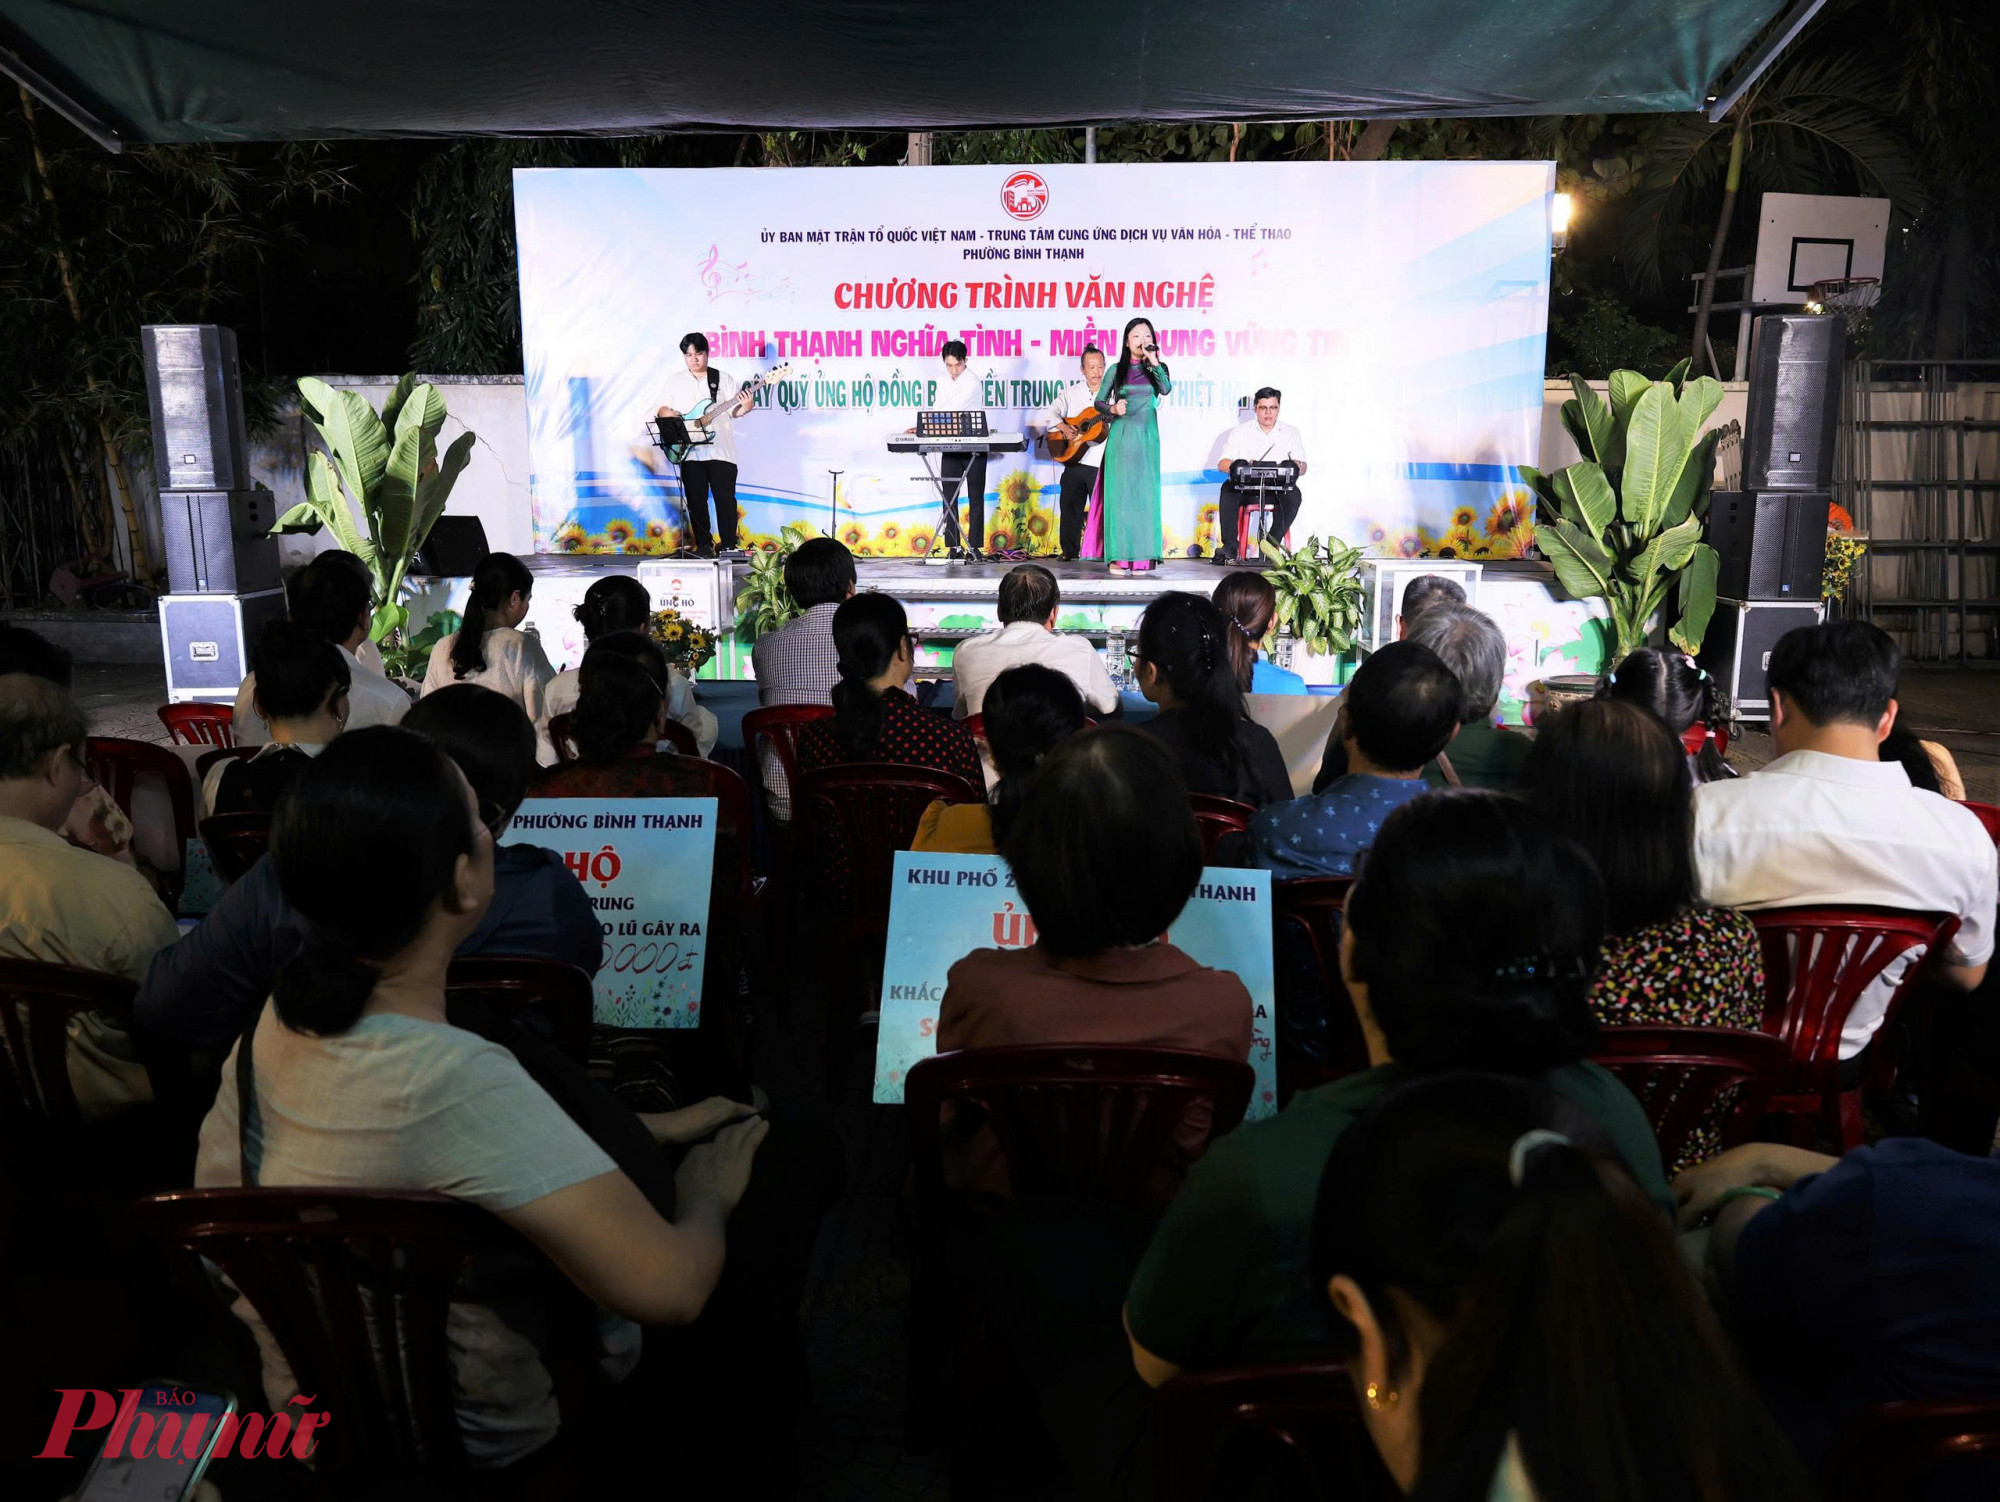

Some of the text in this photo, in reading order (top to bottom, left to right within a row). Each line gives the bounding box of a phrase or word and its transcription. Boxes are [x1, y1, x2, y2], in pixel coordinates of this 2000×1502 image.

[760, 227, 775, 243] ỦY
[780, 231, 802, 243] BAN
[835, 229, 865, 246] TRẬN
[869, 225, 885, 242] TỔ
[887, 226, 918, 244] QUỐC
[921, 228, 947, 245] VIỆT
[951, 230, 976, 241] NAM
[988, 229, 1026, 241] TRUNG
[1030, 226, 1055, 241] TÂM
[1058, 229, 1090, 241] CUNG
[1093, 225, 1117, 241] ỨNG
[1120, 228, 1148, 243] DỊCH
[1152, 228, 1167, 243] VỤ
[1199, 225, 1222, 240] HÓA
[1233, 222, 1258, 240] THỂ
[1261, 228, 1292, 240] THAO
[963, 246, 1085, 262] PHƯỜNG BÌNH THẠNH
[834, 272, 1215, 315] CHƯƠNG TRÌNH VĂN NGHỆ
[707, 325, 766, 358] BÌNH
[773, 330, 863, 365] THẠNH
[871, 323, 949, 358] NGHĨA
[959, 323, 1022, 357] TÌNH
[1050, 316, 1117, 357] MIỀN
[777, 373, 809, 413] QUỸ
[814, 369, 847, 408] ỦNG
[852, 373, 874, 414] HỘ
[878, 368, 922, 408] ĐỒNG
[512, 811, 703, 832] PHƯỜNG BÌNH THẠNH
[564, 845, 622, 889] HỘ
[907, 868, 951, 886] KHU
[956, 867, 999, 888] PHỐ
[591, 896, 635, 911] RUNG
[1192, 884, 1256, 903] HẠNH
[618, 920, 637, 936] LŨ
[642, 919, 675, 936] GÂY
[679, 922, 701, 936] RA
[890, 980, 942, 1002] KHẮC
